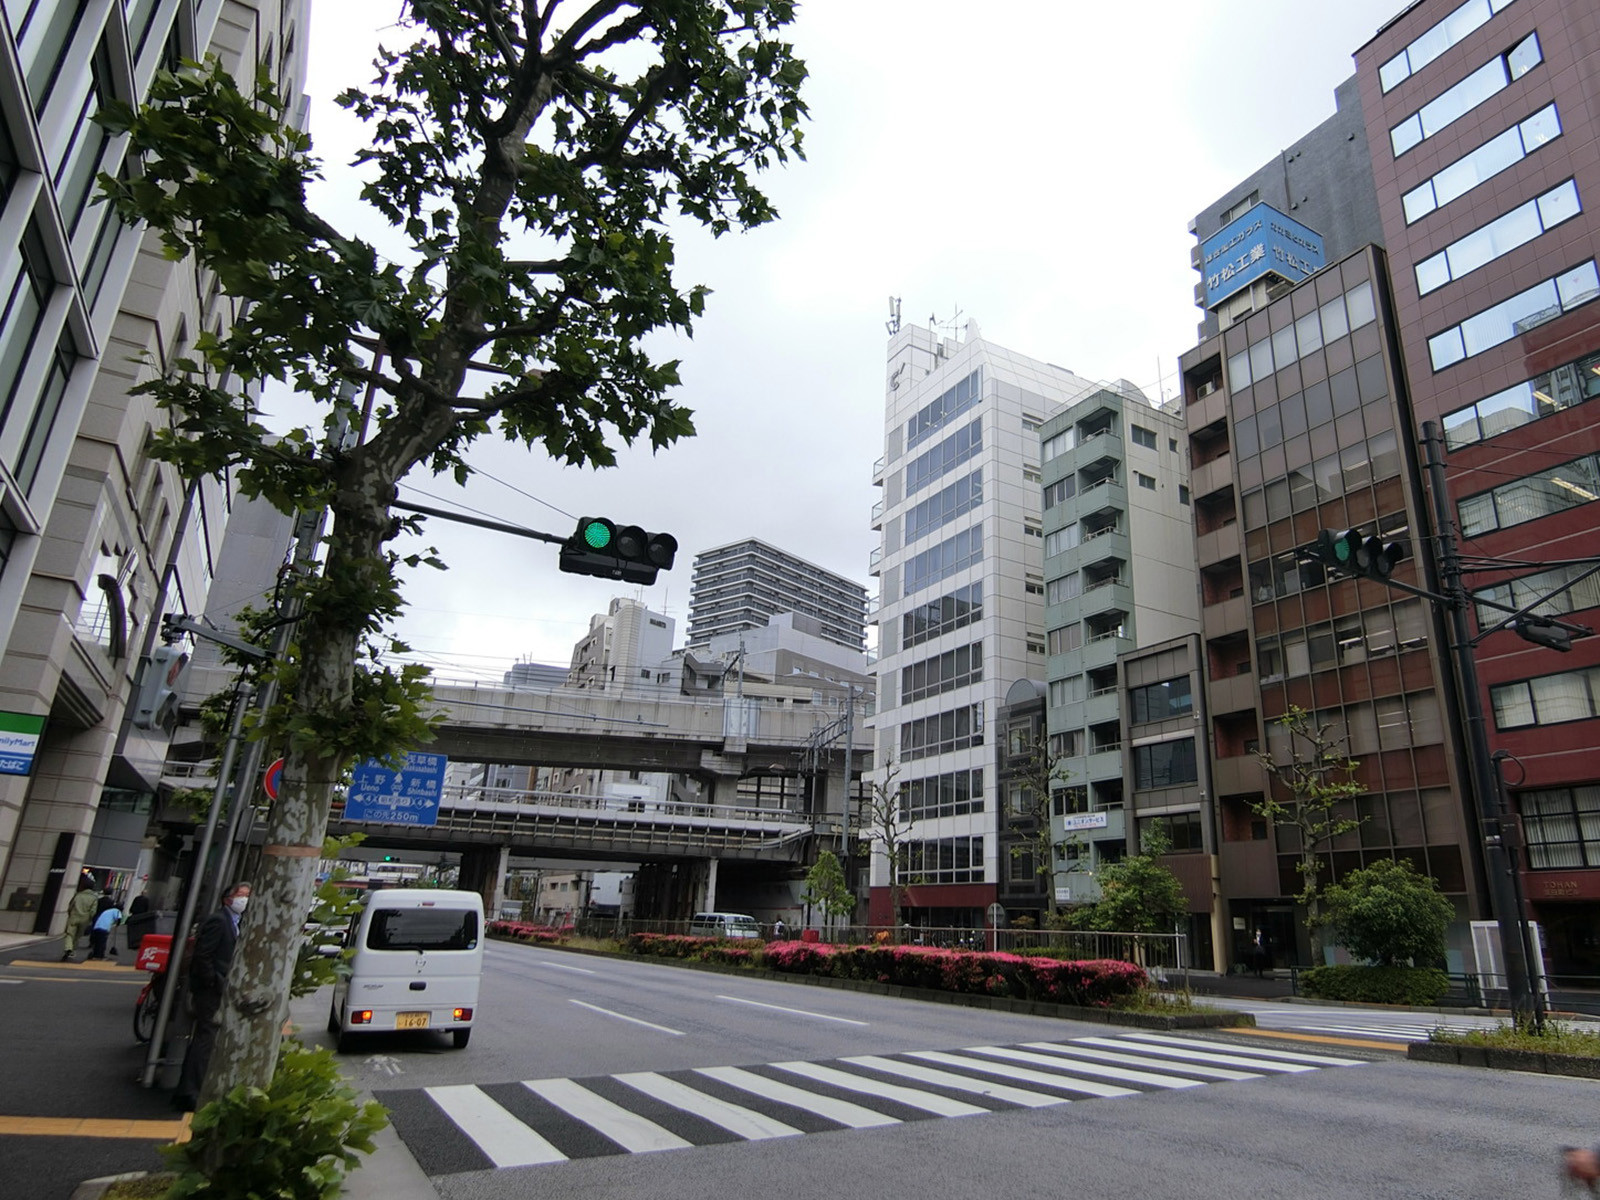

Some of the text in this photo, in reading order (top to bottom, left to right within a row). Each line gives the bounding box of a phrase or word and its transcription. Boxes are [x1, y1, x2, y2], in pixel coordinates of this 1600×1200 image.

[1206, 242, 1266, 290] 竹松工業
[358, 773, 386, 786] 上野
[360, 782, 380, 793] Ueno
[1543, 881, 1578, 889] TOHAN
